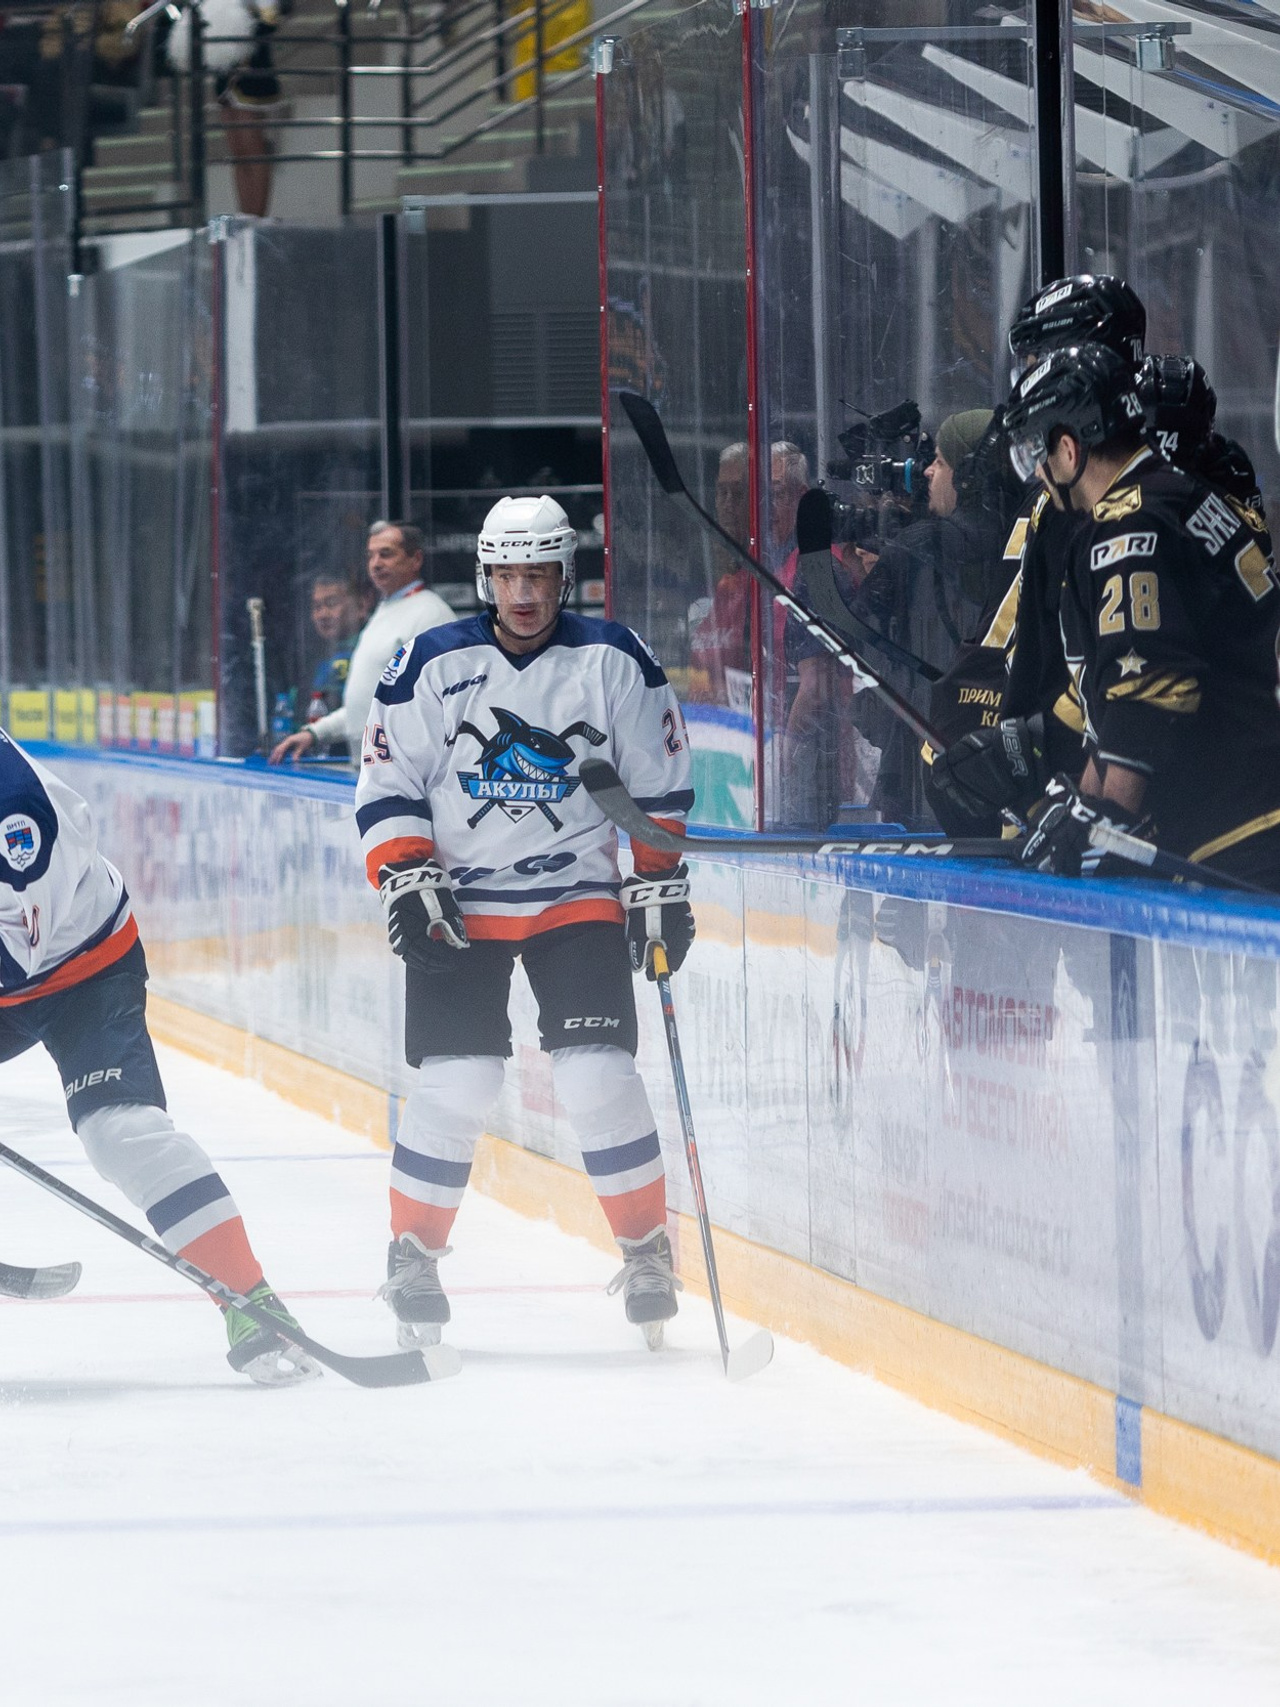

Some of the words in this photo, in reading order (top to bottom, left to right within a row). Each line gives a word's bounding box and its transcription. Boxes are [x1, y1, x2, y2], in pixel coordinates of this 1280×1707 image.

[1121, 392, 1143, 418] 28
[1156, 430, 1179, 452] 74
[1092, 533, 1156, 568] PARI
[1099, 571, 1161, 637] 28
[662, 708, 690, 757] 2
[477, 781, 559, 800] АКУЛЫ
[817, 843, 954, 856] CCM
[563, 1017, 621, 1030] CCM
[141, 1237, 251, 1309] CCM
